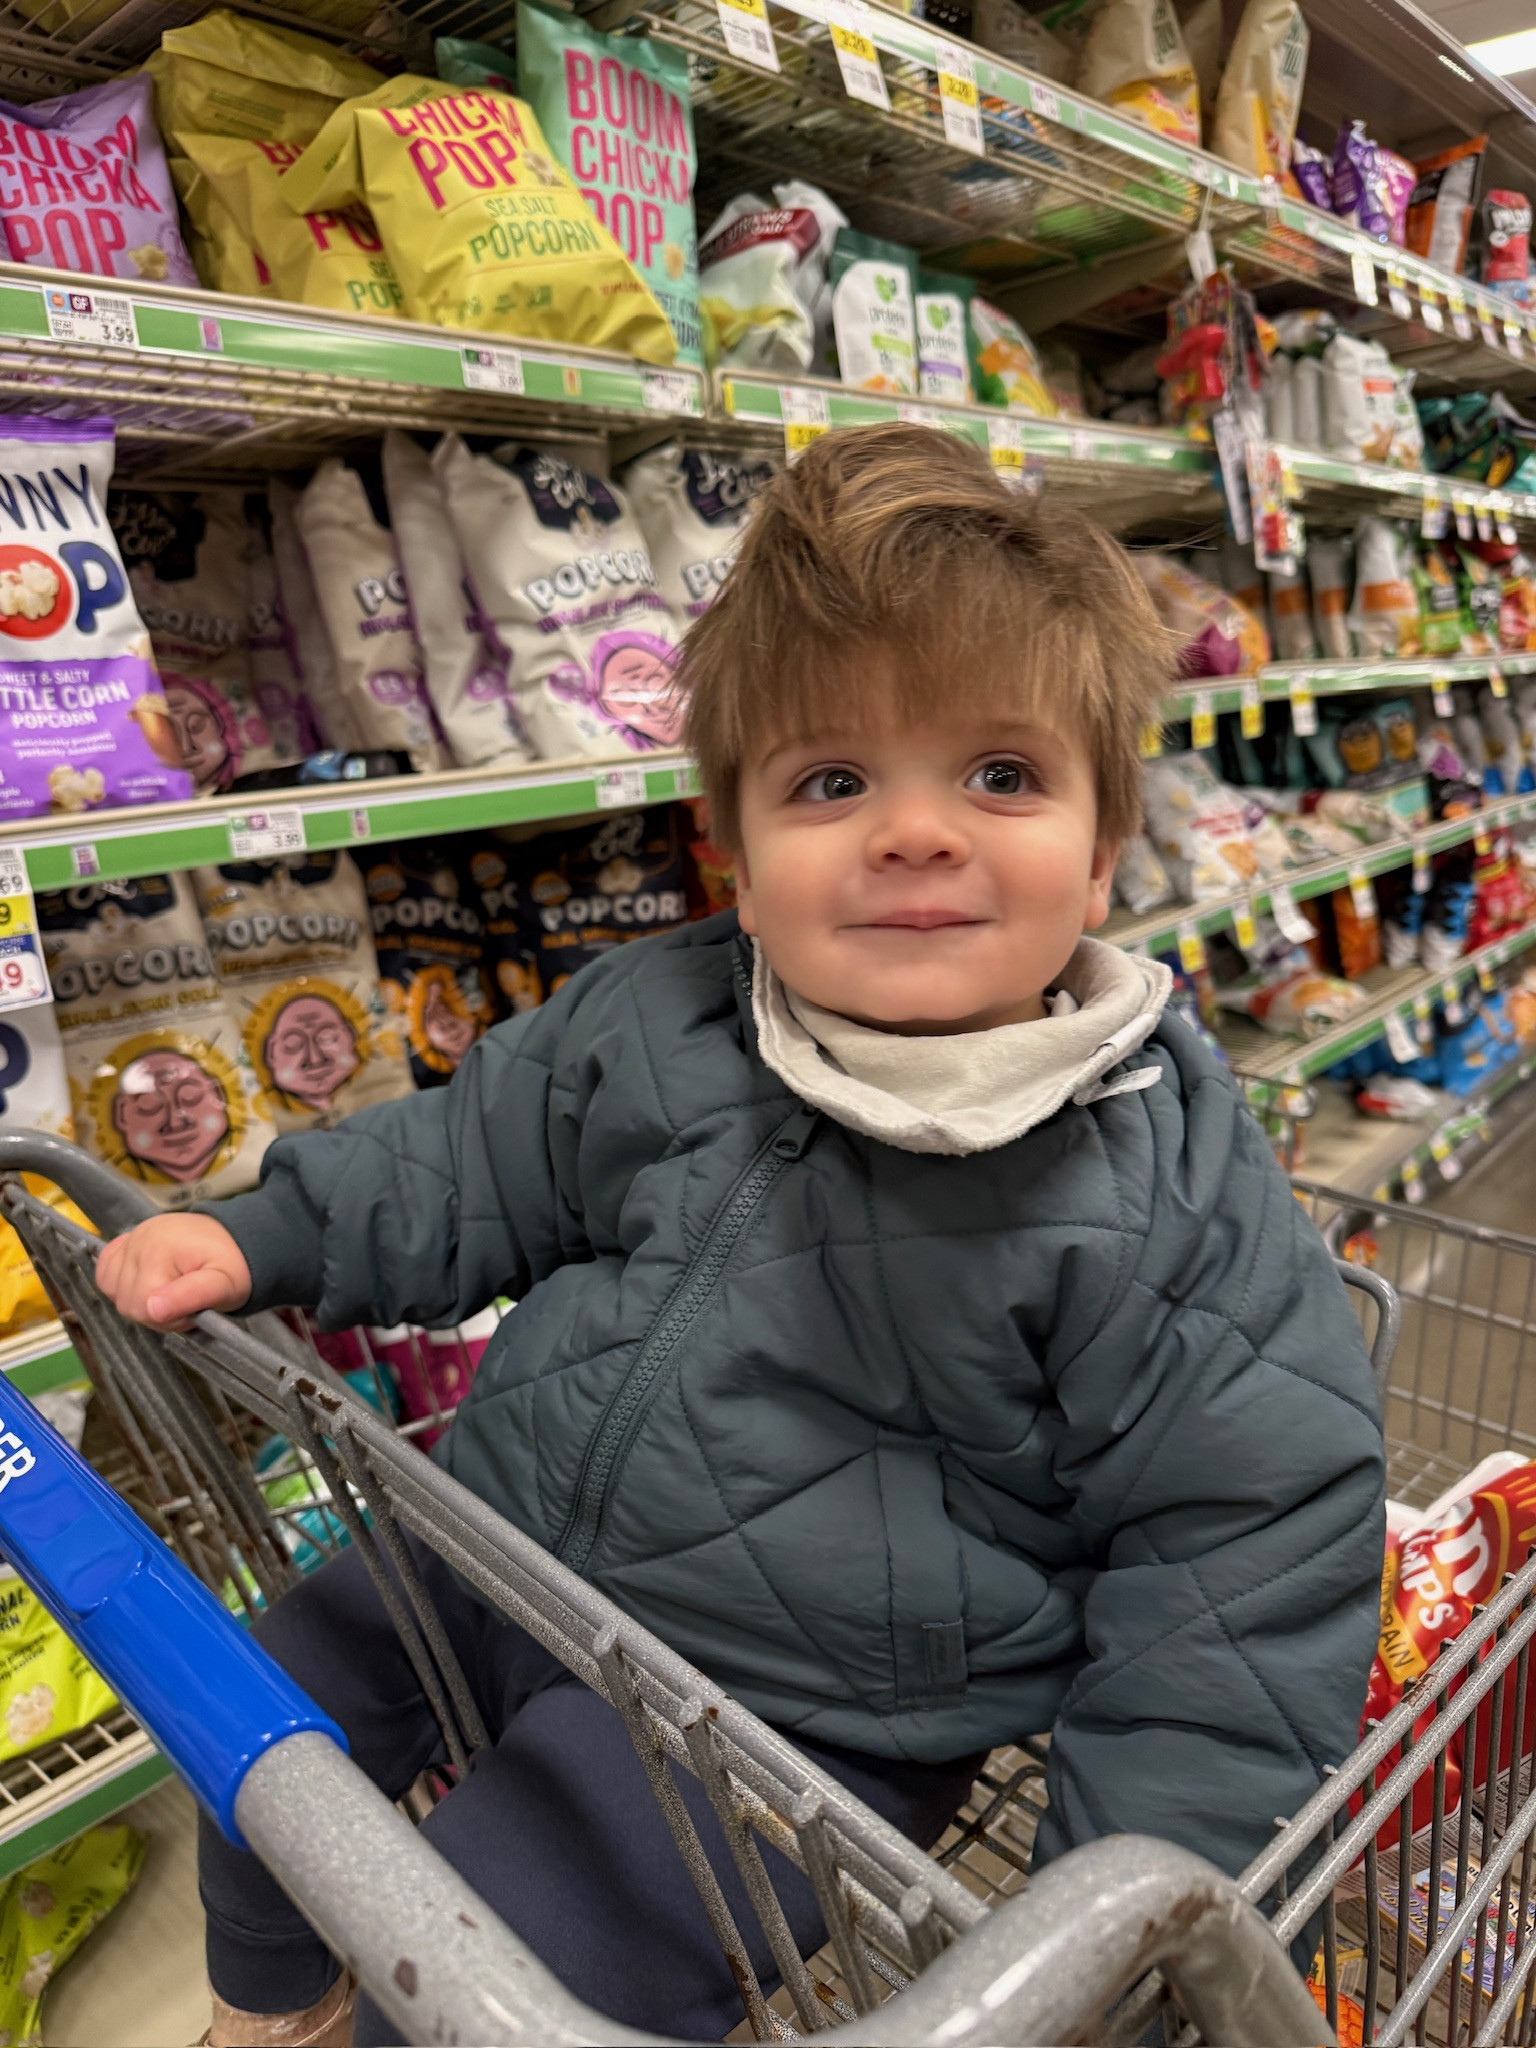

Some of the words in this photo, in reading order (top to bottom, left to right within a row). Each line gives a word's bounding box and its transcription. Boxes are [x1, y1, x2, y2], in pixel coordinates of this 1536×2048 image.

[564, 48, 688, 155] BOOM
[0, 158, 163, 214] CHICKA
[408, 130, 517, 211] POP
[484, 198, 516, 218] SEA
[521, 196, 558, 216] SALT
[2, 208, 128, 279] POP
[467, 219, 601, 265] POPCORN
[100, 323, 135, 343] 3.99
[41, 673, 52, 684] &
[54, 668, 91, 685] SALTY
[60, 680, 131, 710] CORN
[11, 709, 98, 730] POPCORN
[0, 1418, 36, 1494] ER
